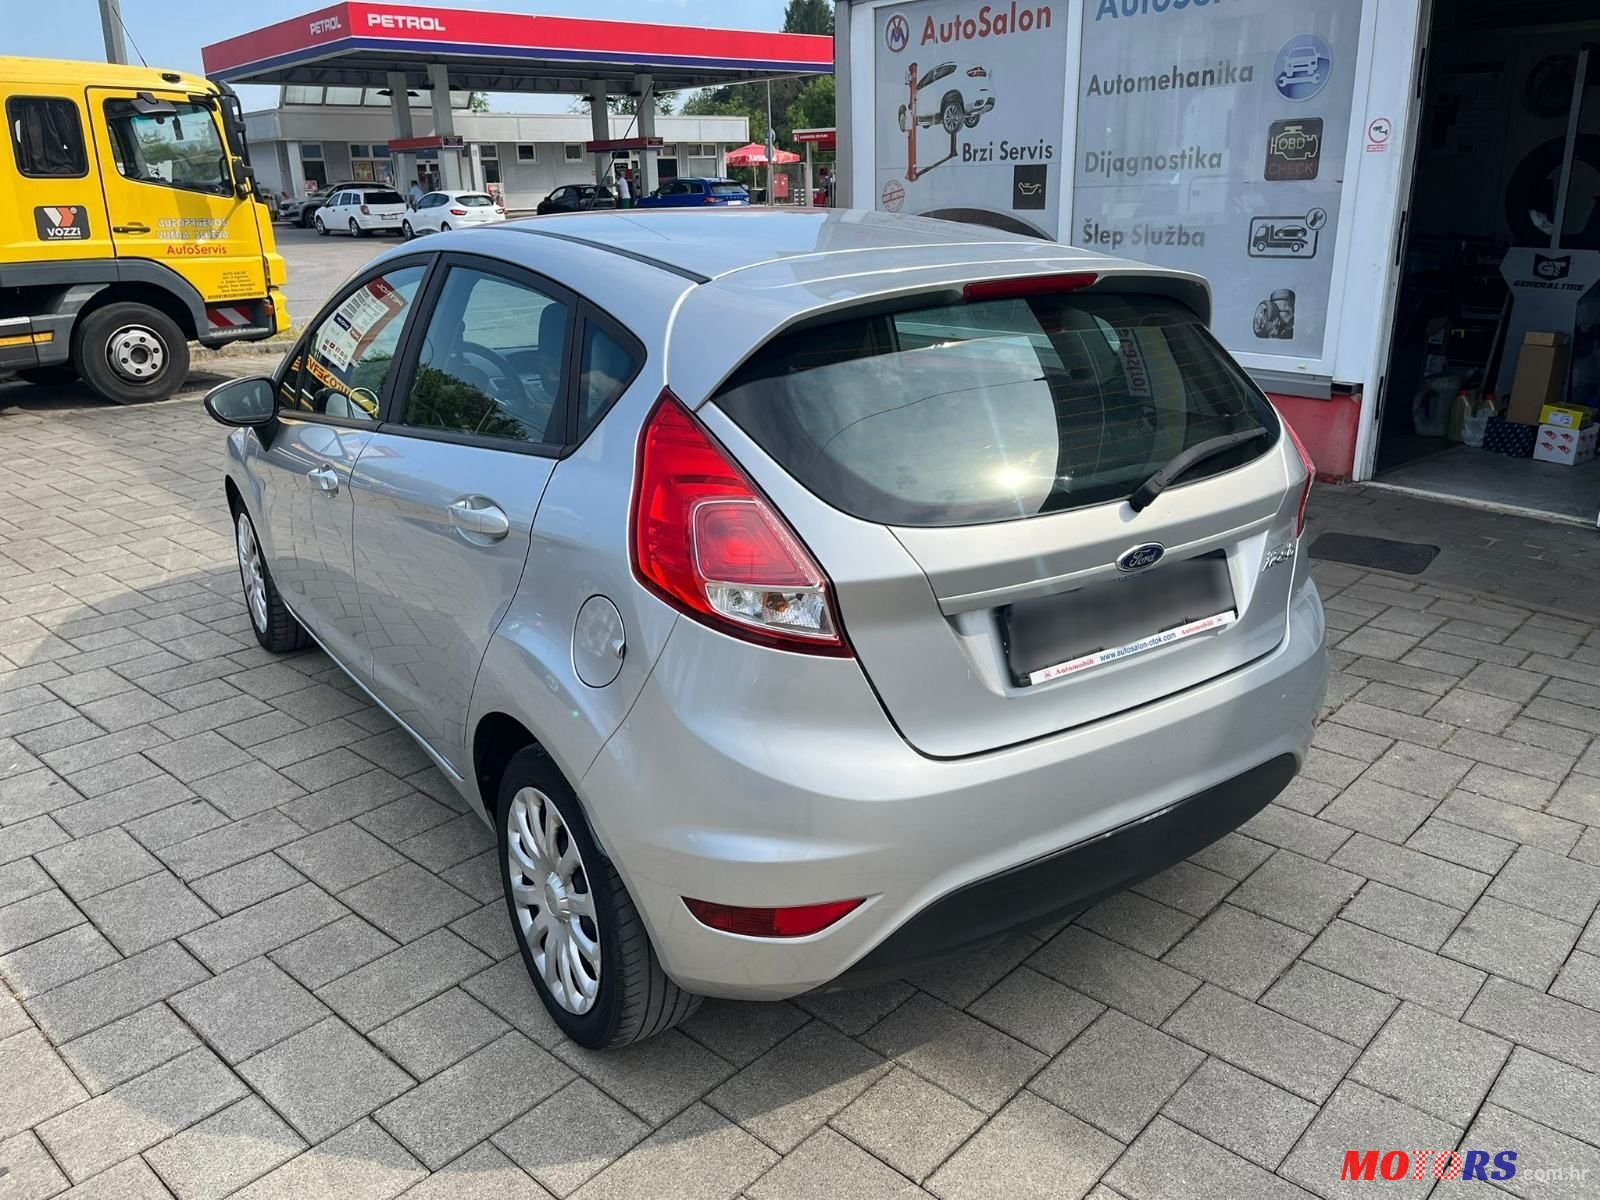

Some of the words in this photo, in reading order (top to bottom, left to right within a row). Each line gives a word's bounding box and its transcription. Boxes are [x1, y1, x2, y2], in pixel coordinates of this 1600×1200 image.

[310, 16, 341, 36] PETROL
[367, 13, 446, 31] PETROL
[920, 2, 1052, 46] AutoSalon
[1086, 62, 1253, 97] Automehanika
[962, 141, 993, 162] Brzi
[999, 138, 1053, 161] Servis
[1278, 137, 1305, 150] OBD
[1084, 147, 1222, 178] Dijagnostika
[1269, 161, 1314, 177] CHECK
[1082, 218, 1124, 250] Šlep
[1131, 223, 1205, 247] Služba
[166, 243, 227, 255] AutoServis
